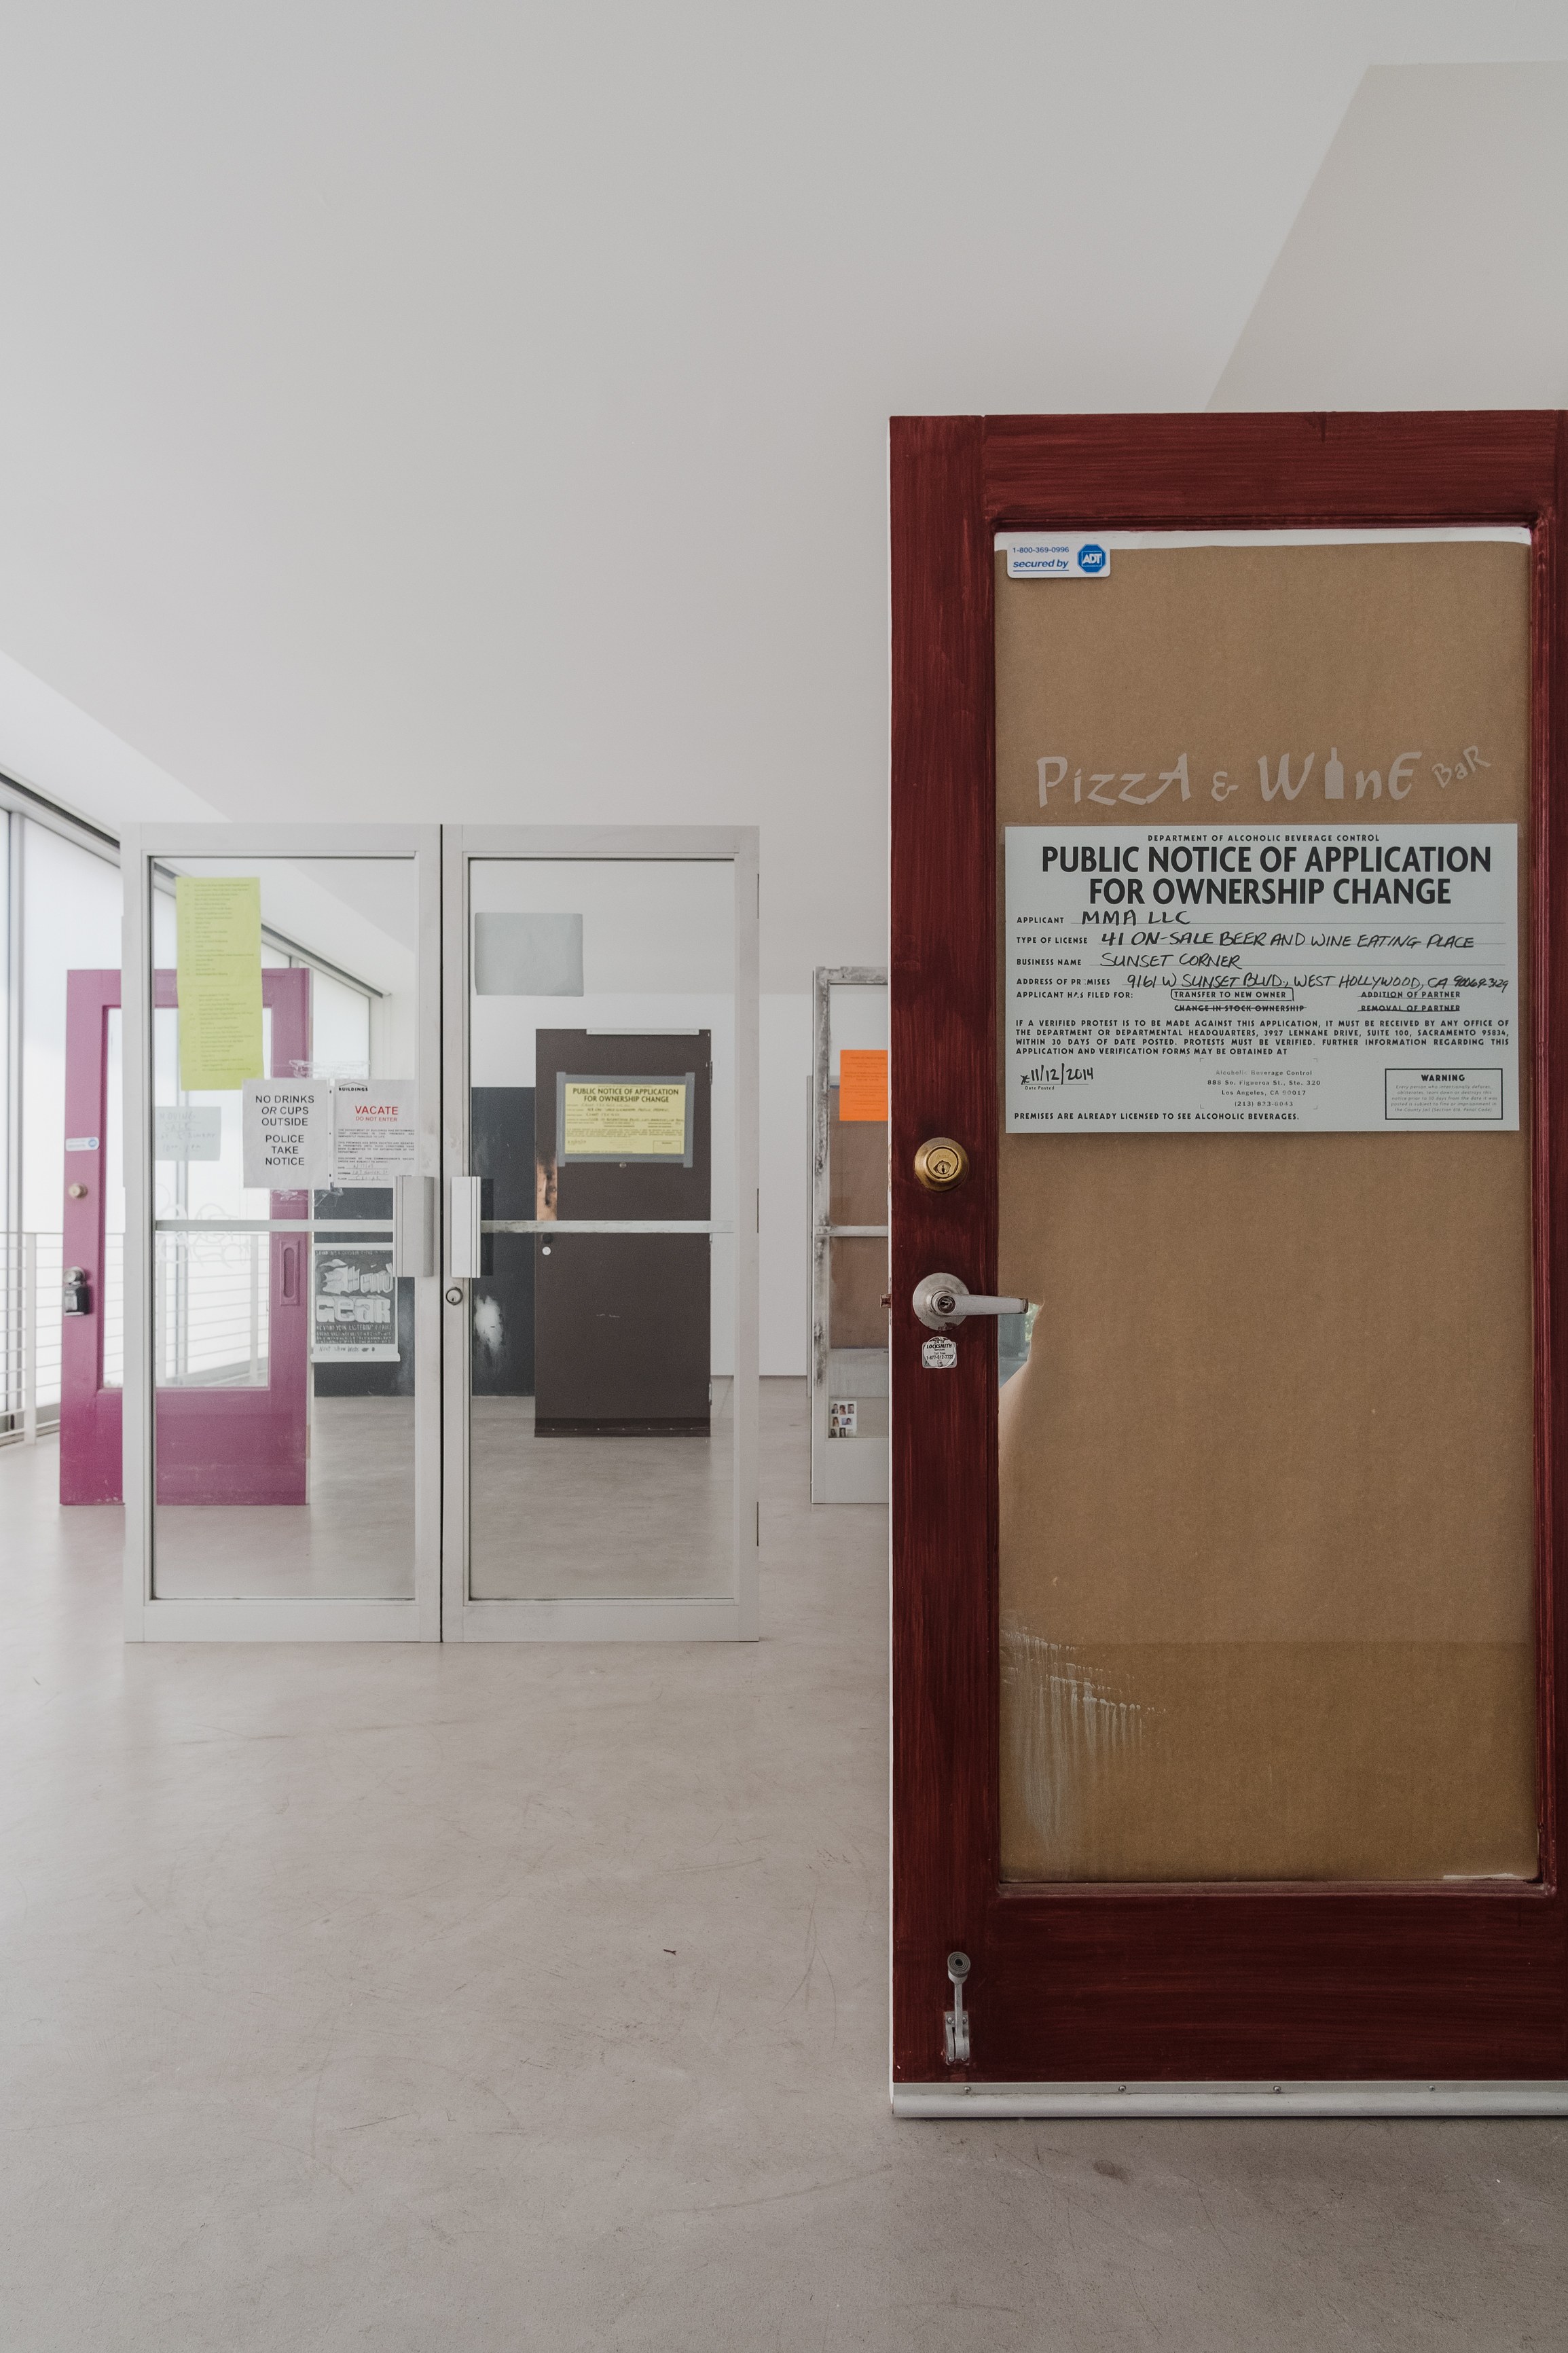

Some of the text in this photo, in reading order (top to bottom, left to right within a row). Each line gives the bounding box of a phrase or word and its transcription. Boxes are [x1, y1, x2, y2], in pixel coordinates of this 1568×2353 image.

[1013, 559, 1069, 569] secured by
[1082, 552, 1103, 567] ADT
[1211, 770, 1239, 802] &
[1043, 846, 1491, 872] PUBLIC NOTICE OF APPLICATION
[1091, 878, 1451, 904] FOR OWNERSHIP CHANGE
[1082, 910, 1190, 926] MMA LLC
[1101, 931, 1474, 948] 41 ON-SALE BEER AND WINE EATING PLACE
[1100, 953, 1242, 969] SUNSET CORNER
[1127, 975, 1156, 988] 9161
[1163, 973, 1176, 987] W
[1182, 974, 1240, 988] SUNSET
[1294, 975, 1336, 987] WEST
[1428, 978, 1448, 988] CA
[1189, 1029, 1258, 1037] HEADQUARTERS,
[255, 1095, 314, 1103] NO DRINKS
[261, 1107, 309, 1115] OR CUPS
[354, 1106, 399, 1115] VACATE
[261, 1117, 308, 1126] OUTSIDE
[266, 1134, 304, 1143] POLICE
[272, 1146, 299, 1154] TAKE
[265, 1157, 305, 1166] NOTICE
